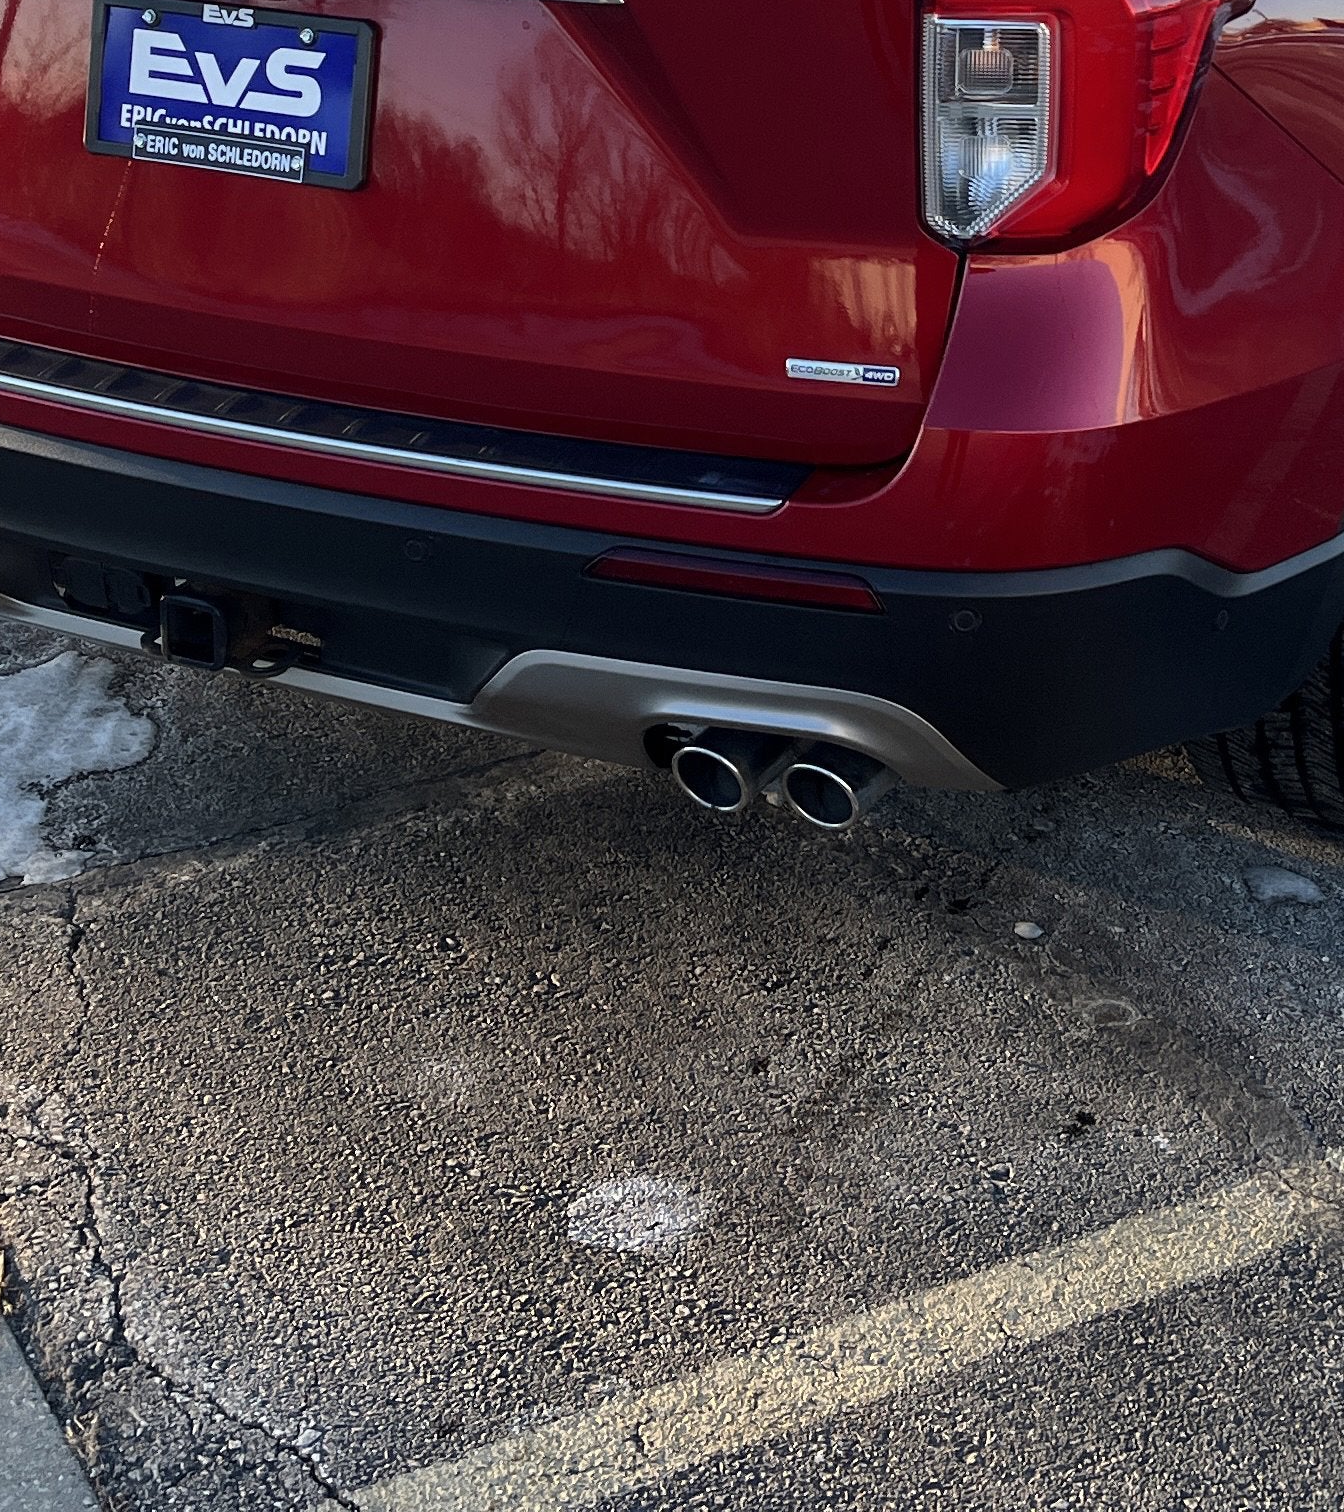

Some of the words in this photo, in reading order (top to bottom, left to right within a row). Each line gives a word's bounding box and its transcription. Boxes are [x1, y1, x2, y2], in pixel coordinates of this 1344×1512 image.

[129, 28, 327, 118] EvS
[146, 134, 179, 155] ERIC
[182, 143, 205, 160] von
[208, 143, 291, 173] SCHLEDORN
[865, 370, 894, 381] 4WD
